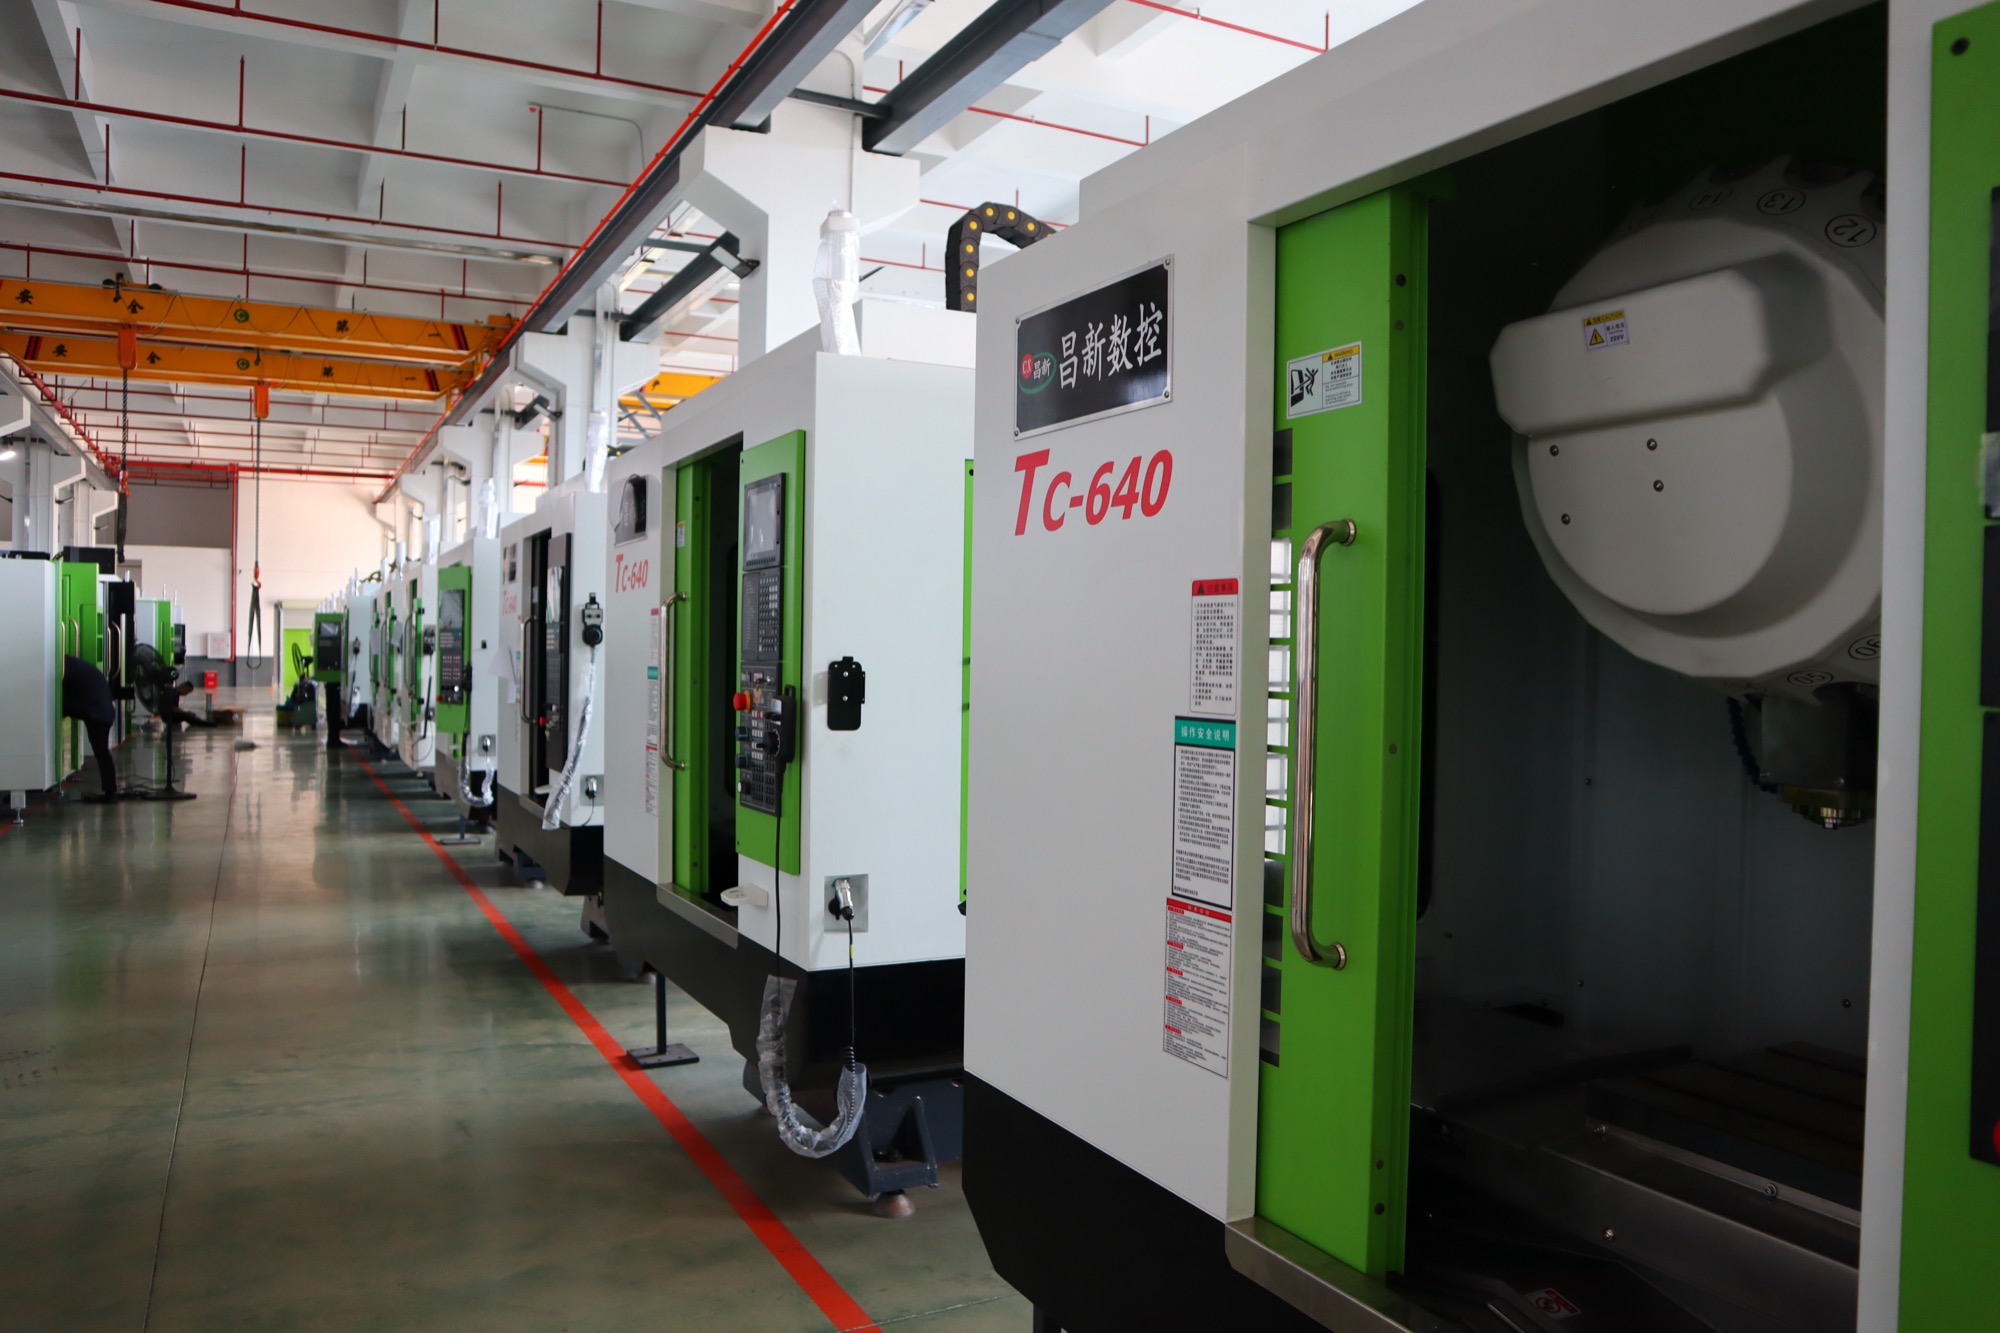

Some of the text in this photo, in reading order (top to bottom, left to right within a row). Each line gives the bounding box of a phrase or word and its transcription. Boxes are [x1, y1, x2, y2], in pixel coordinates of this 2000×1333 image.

[1764, 192, 1796, 211] 13
[1833, 218, 1867, 243] 12
[1058, 301, 1164, 390] 昌新数控
[1610, 334, 1624, 342] 220V
[1022, 359, 1033, 375] CX
[1033, 358, 1051, 380] 昌新
[1793, 671, 1826, 685] 05
[1180, 725, 1230, 742] 操作安全说明
